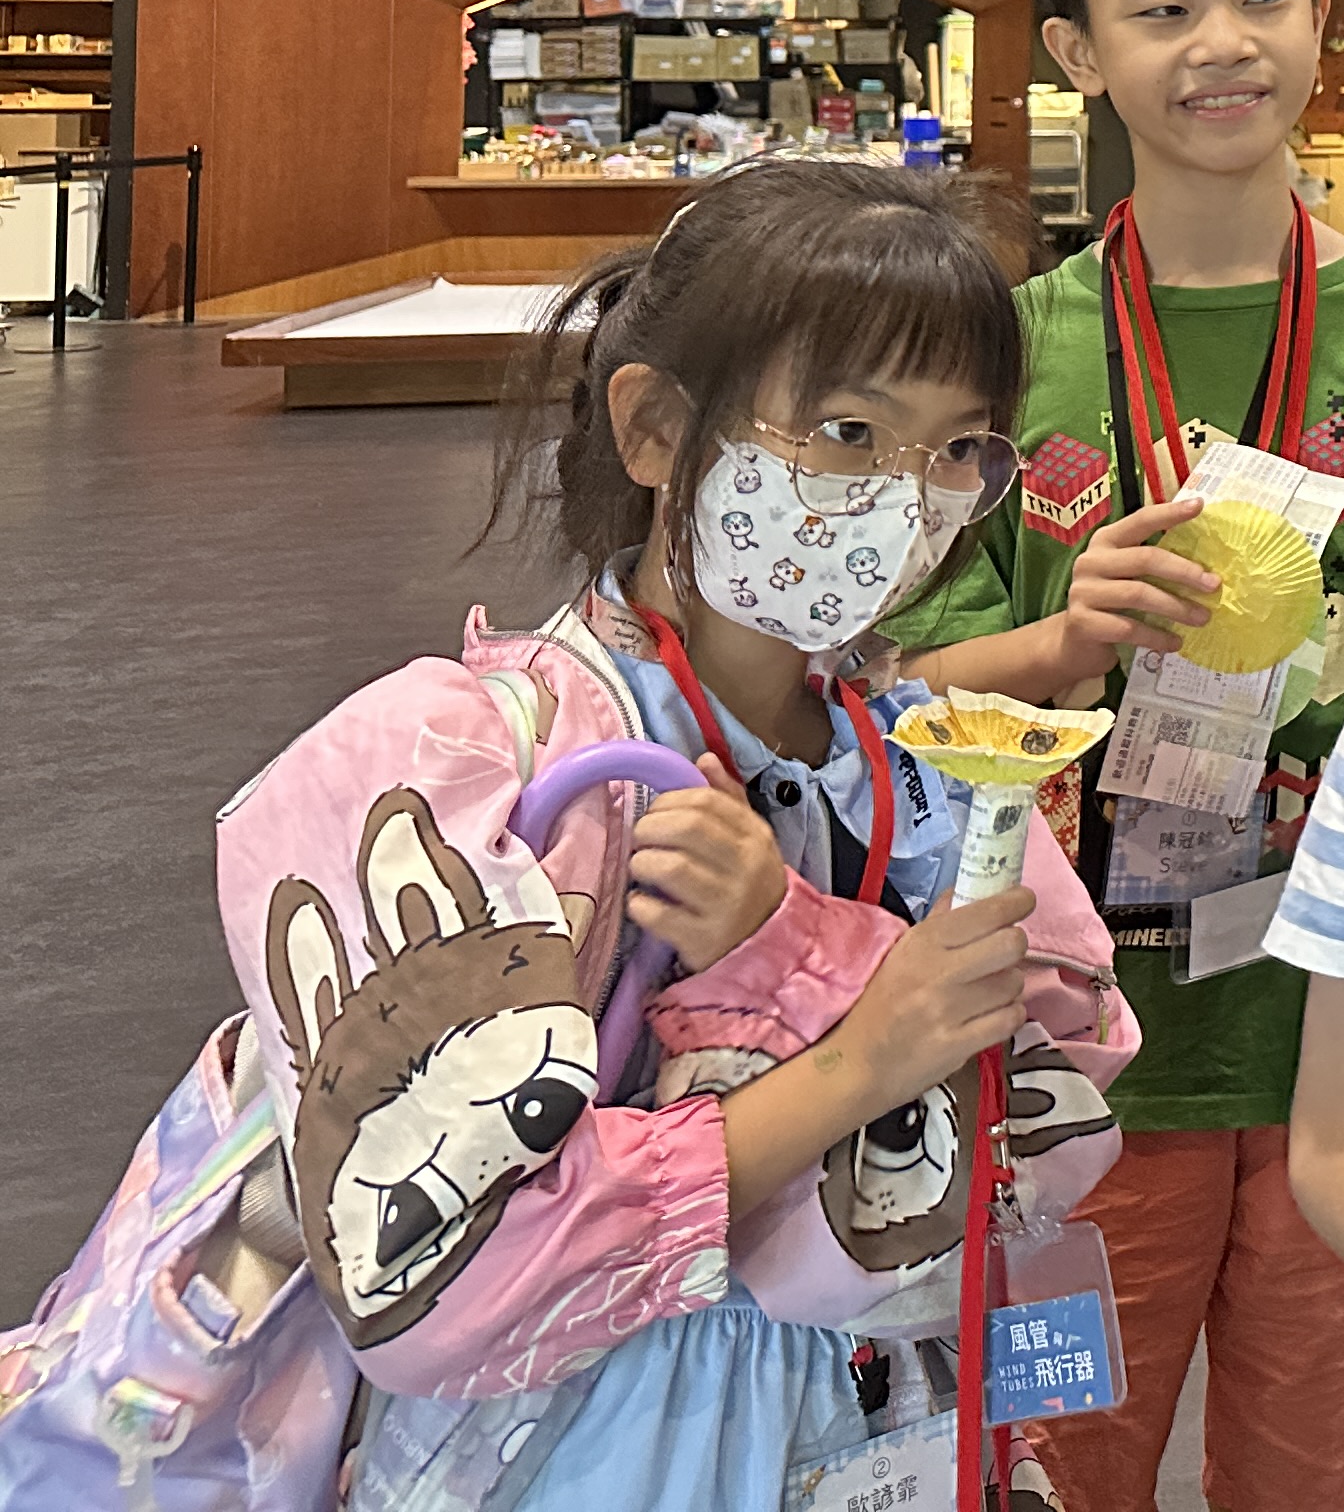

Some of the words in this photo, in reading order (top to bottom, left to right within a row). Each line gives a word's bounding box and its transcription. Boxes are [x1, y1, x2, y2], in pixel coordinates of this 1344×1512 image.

[1026, 493, 1062, 523] TNT
[1069, 480, 1105, 520] TNT
[998, 1361, 1027, 1379] WIND
[1034, 1349, 1095, 1388] 飛行器
[1001, 1375, 1035, 1393] TUBES
